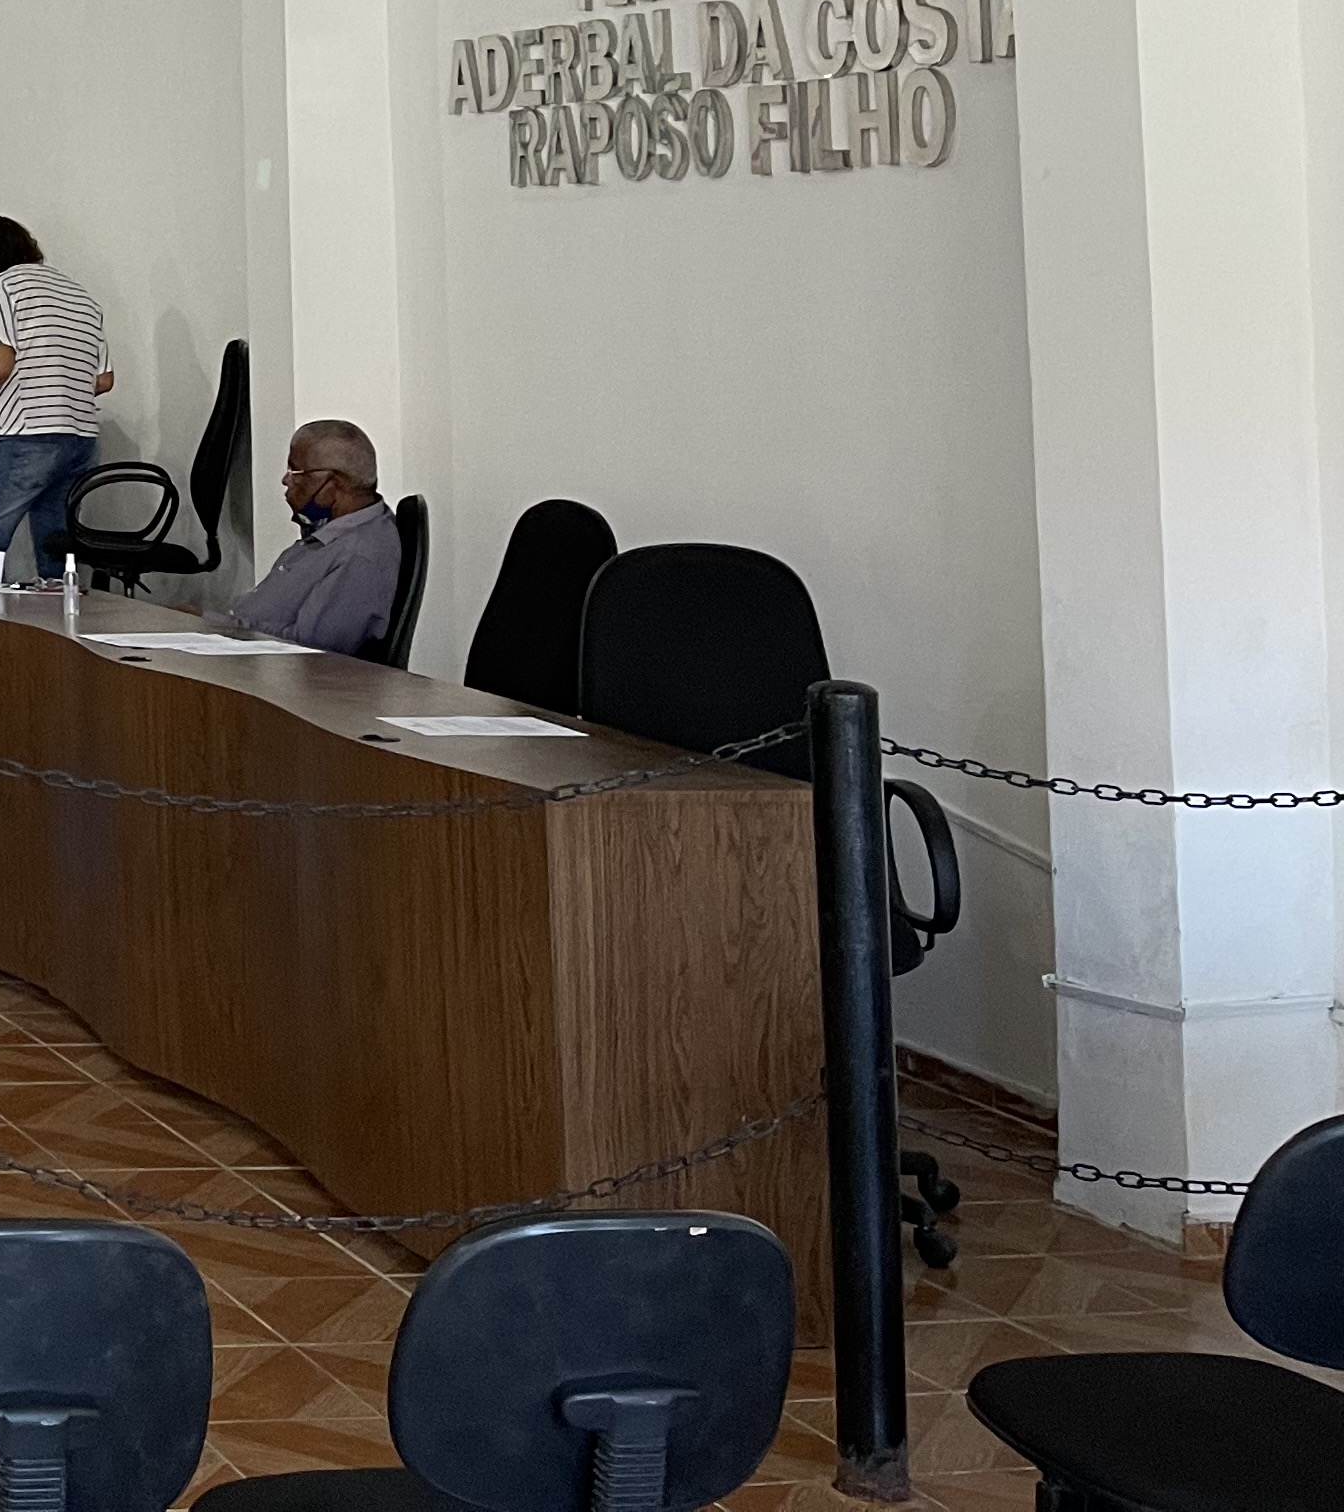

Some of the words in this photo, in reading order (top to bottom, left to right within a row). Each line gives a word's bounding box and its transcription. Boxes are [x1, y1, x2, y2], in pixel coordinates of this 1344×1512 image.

[449, 9, 691, 116] ADERBAL
[509, 86, 734, 187] RAPOSO
[751, 67, 956, 176] FILHO
